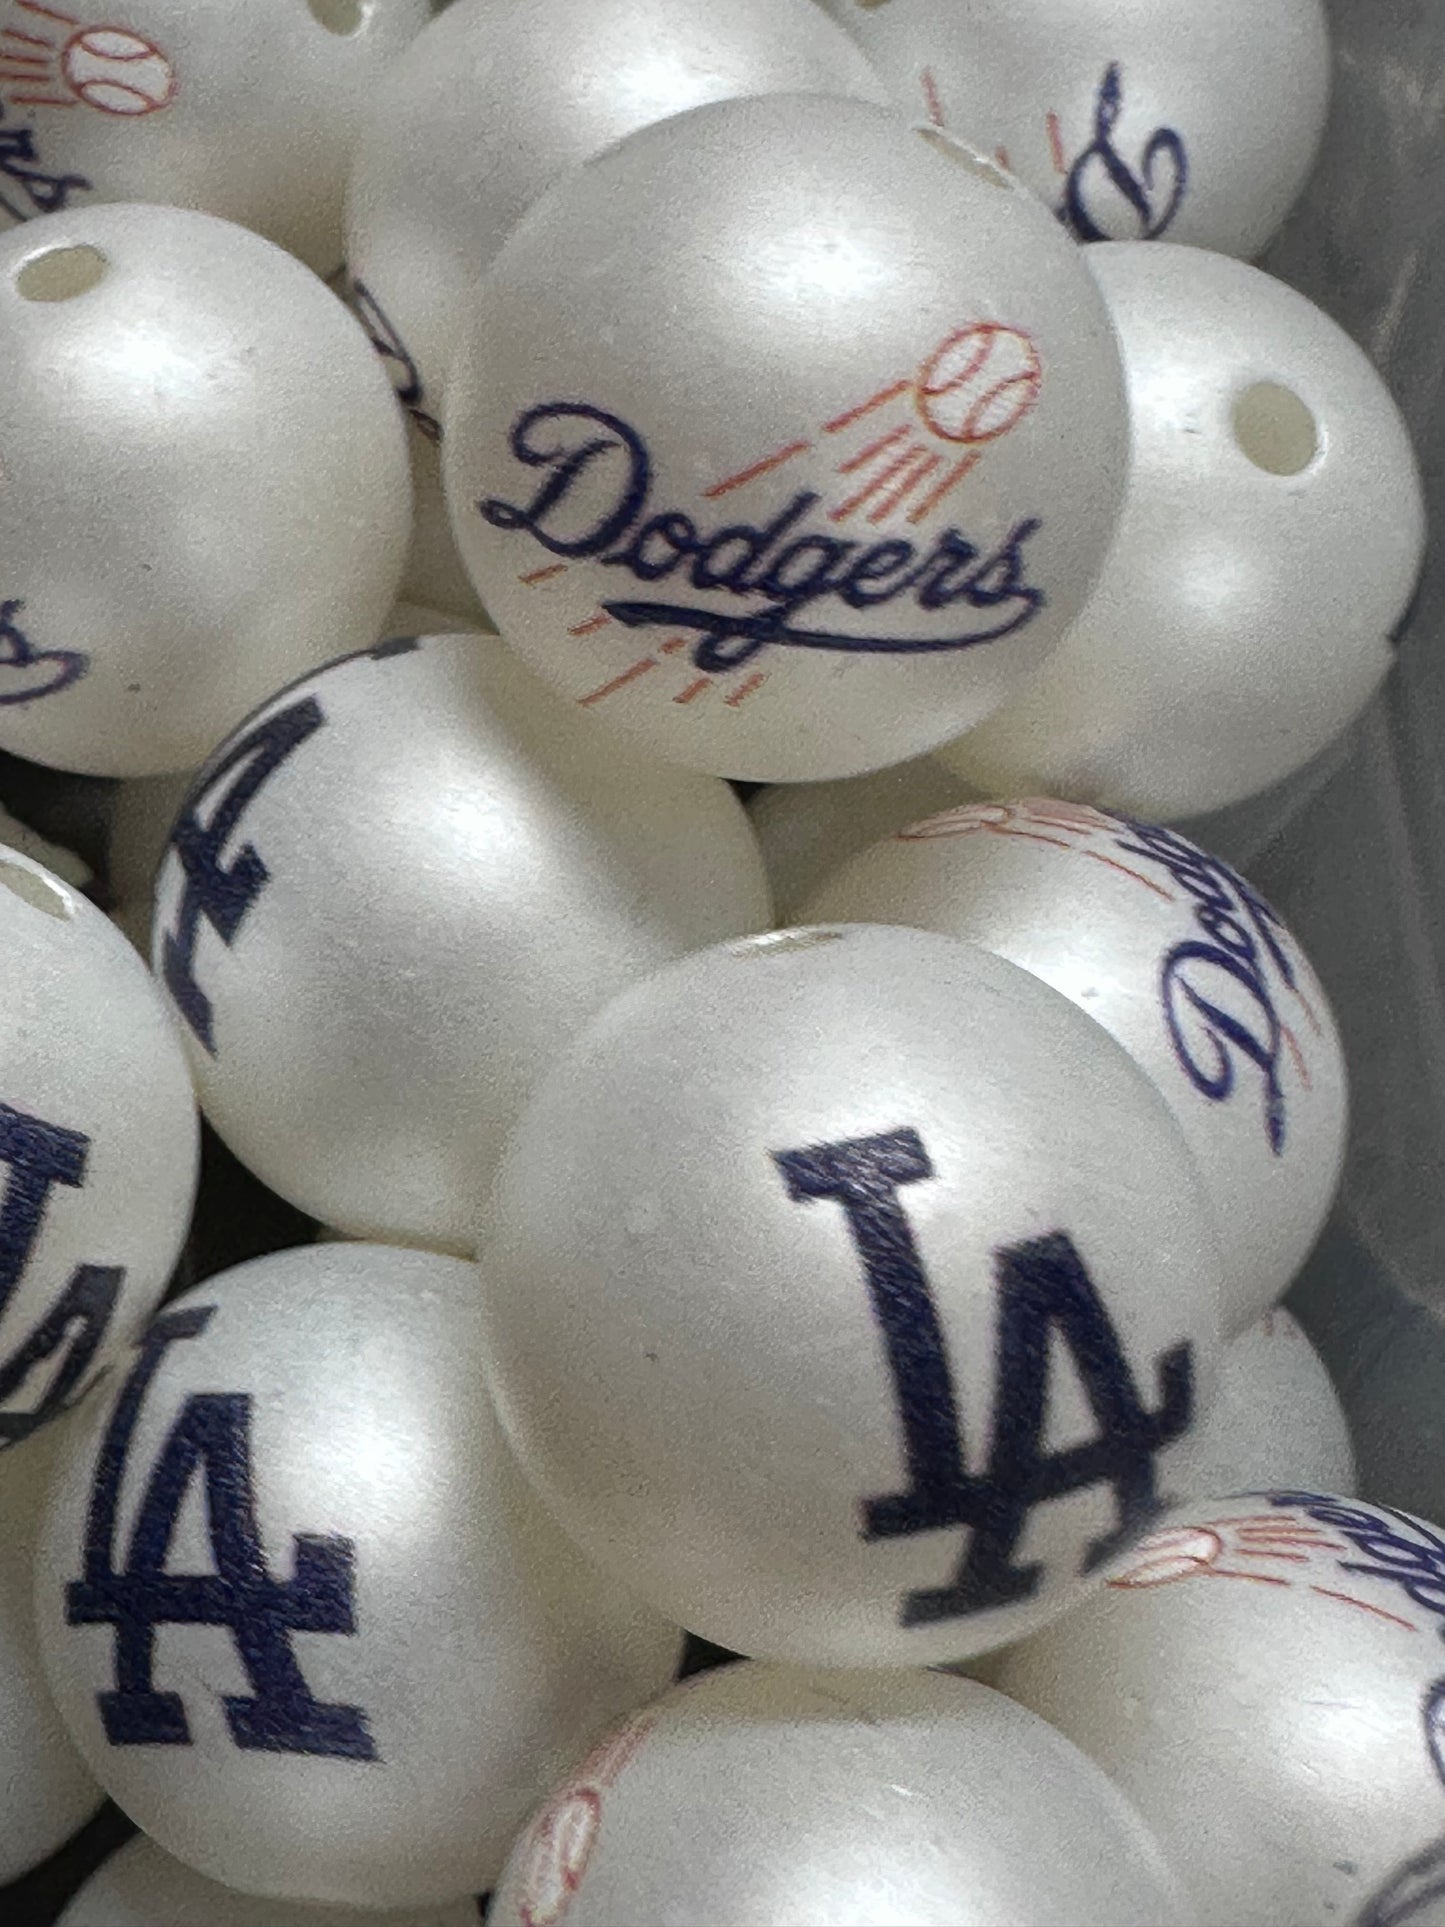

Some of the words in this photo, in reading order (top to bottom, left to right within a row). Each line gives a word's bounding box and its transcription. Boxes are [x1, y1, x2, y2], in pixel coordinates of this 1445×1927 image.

[479, 402, 1044, 673] Dodgers
[63, 1304, 385, 1764] LA
[768, 1126, 1200, 1628] LA
